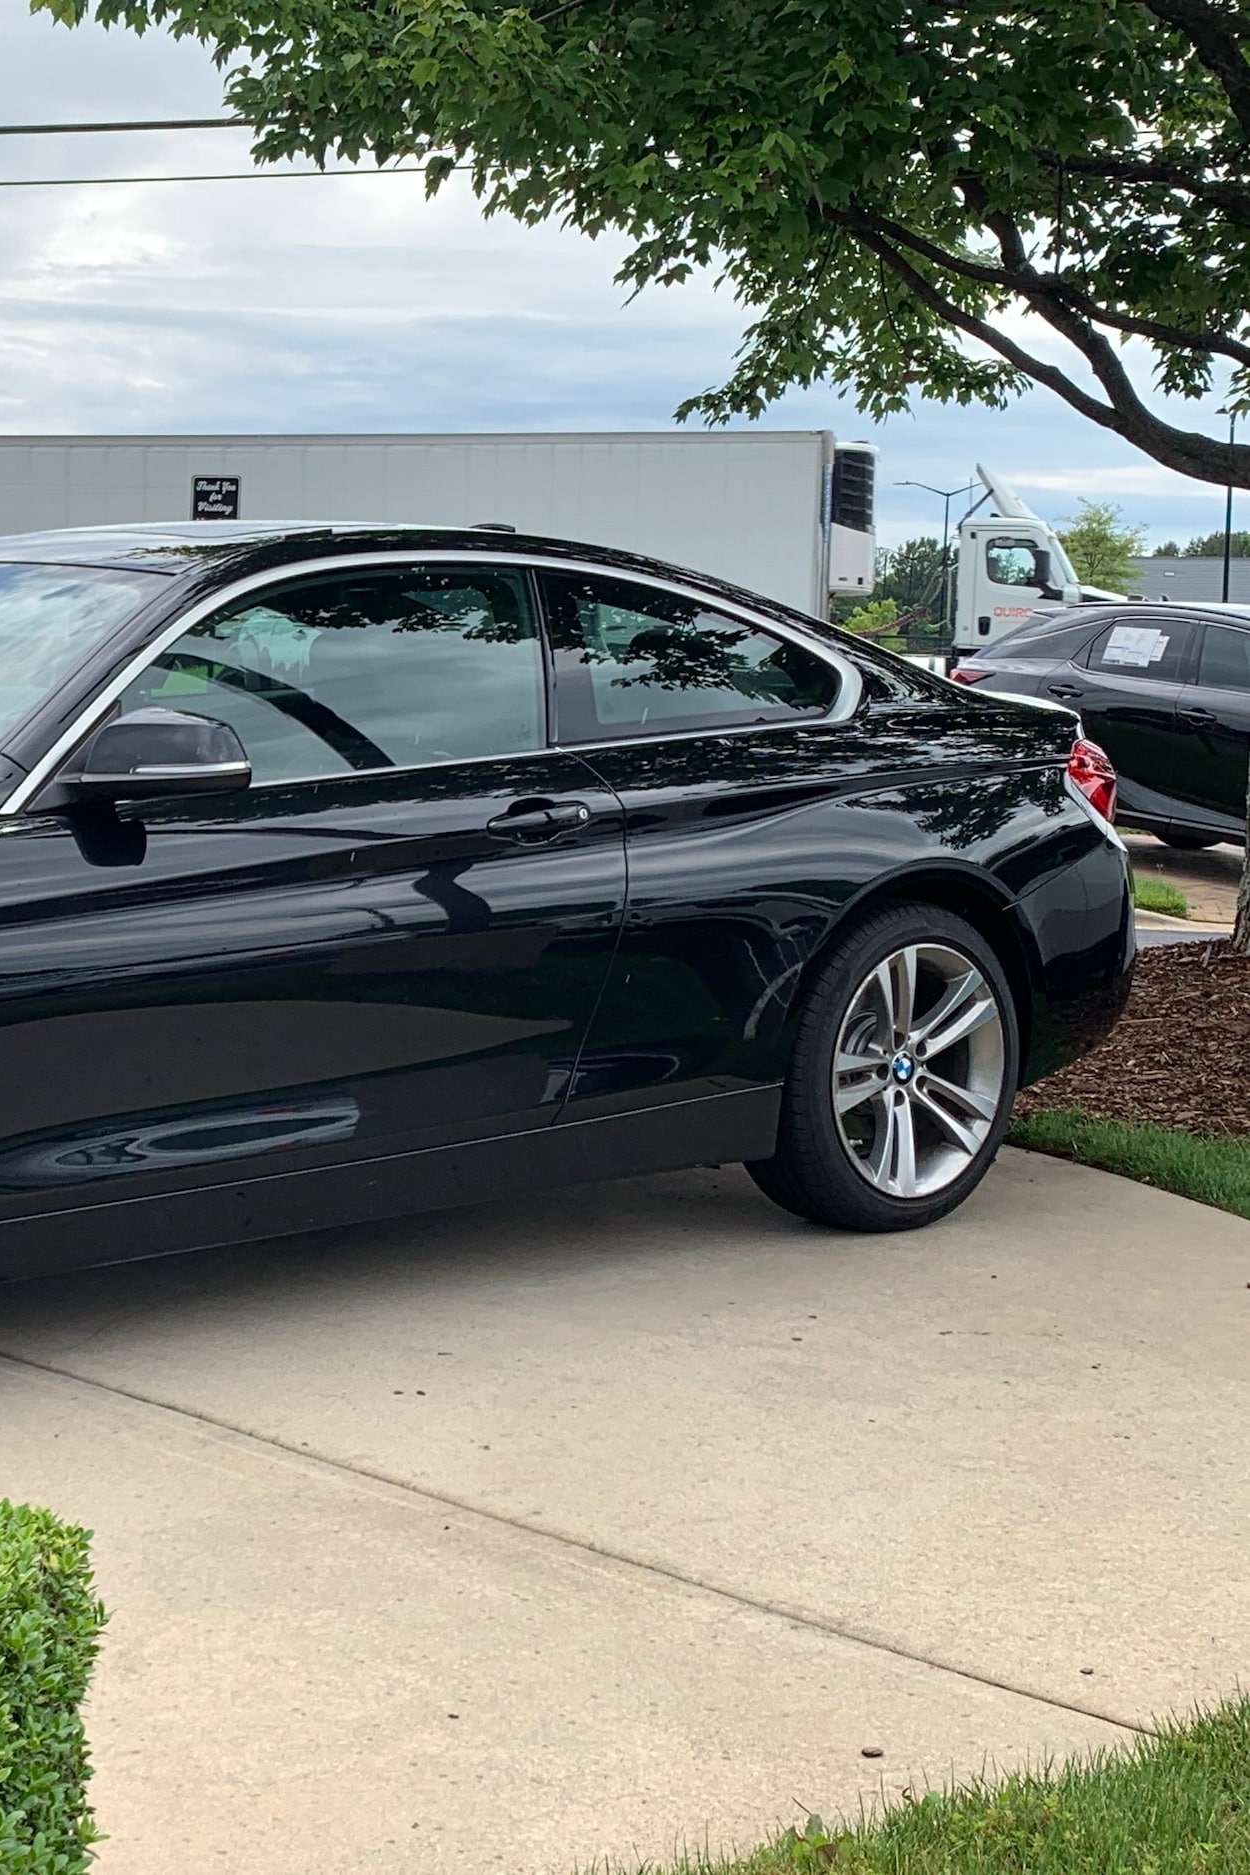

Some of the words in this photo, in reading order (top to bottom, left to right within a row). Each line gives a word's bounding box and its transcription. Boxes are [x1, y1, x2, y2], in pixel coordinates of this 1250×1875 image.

[196, 480, 221, 491] Thank
[221, 481, 237, 494] You
[209, 492, 223, 502] for
[197, 501, 233, 515] Visiting
